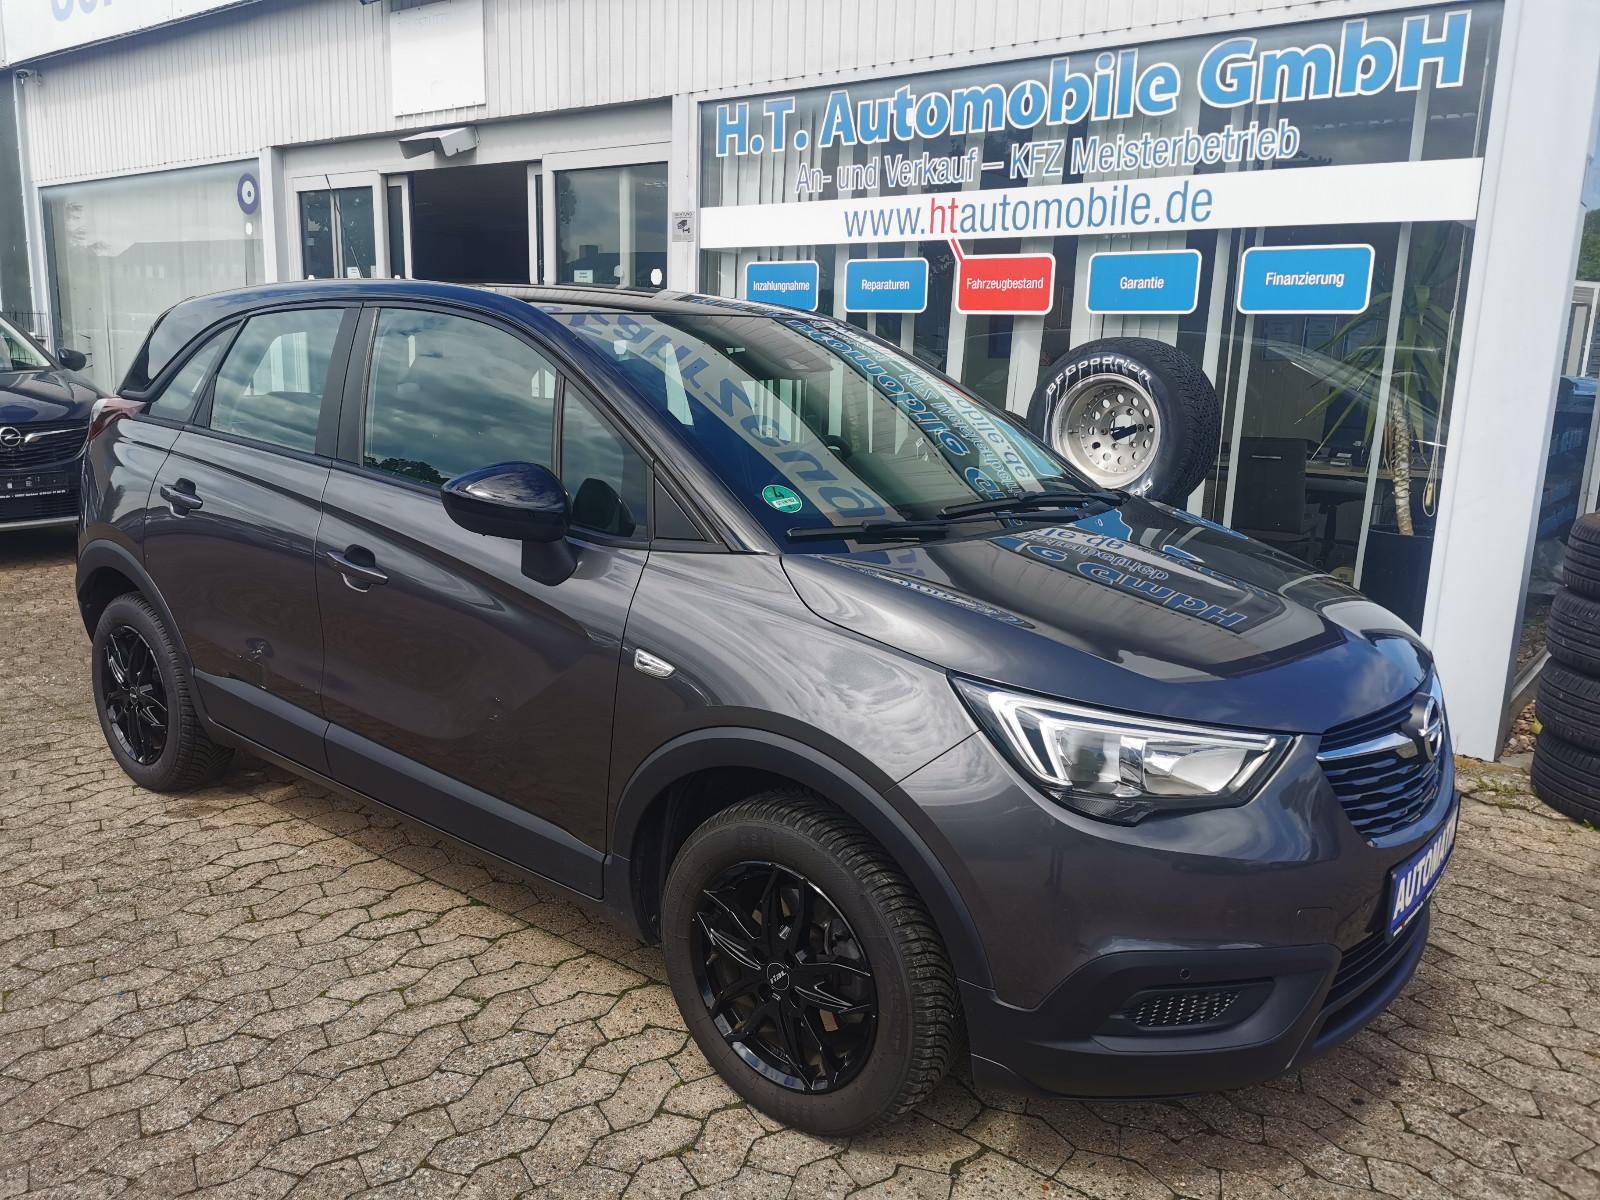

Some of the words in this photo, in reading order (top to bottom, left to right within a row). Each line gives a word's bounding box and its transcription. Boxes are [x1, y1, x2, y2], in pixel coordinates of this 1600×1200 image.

[716, 96, 809, 157] H.T.
[818, 48, 1181, 148] Automobile
[1197, 9, 1472, 108] GmbH
[794, 163, 831, 193] An-
[837, 158, 880, 190] und
[884, 147, 978, 187] Verkauf
[1009, 139, 1065, 180] KFZ
[1070, 118, 1300, 175] Meisterbetrieb
[844, 180, 1213, 237] www.htautomobile.de
[753, 280, 810, 293] Inzahlungnahme
[861, 279, 910, 292] Reparaturen
[966, 276, 1045, 291] Fahrzeugbestand
[1120, 276, 1164, 289] Garantie
[1265, 271, 1345, 288] Finanzierung
[1047, 355, 1151, 395] BFGoodrich
